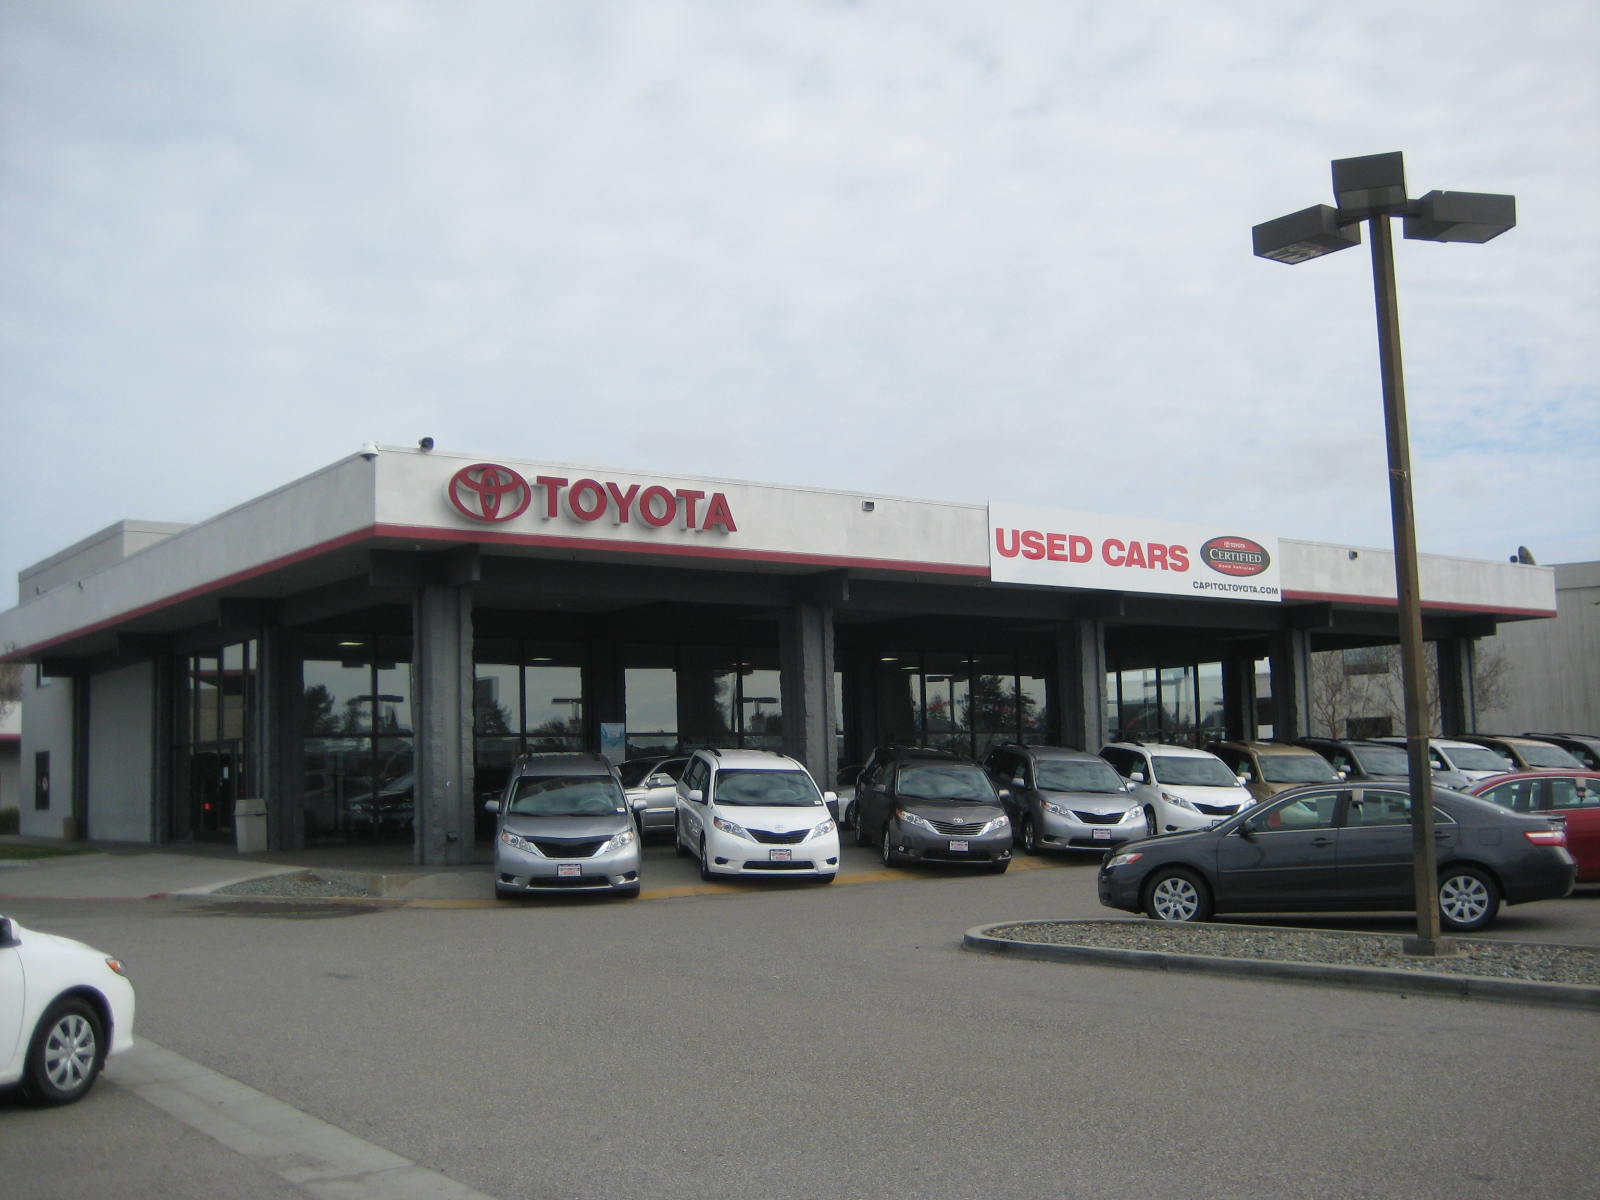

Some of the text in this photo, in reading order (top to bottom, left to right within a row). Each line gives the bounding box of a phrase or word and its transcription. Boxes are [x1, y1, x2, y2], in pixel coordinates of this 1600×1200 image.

[536, 475, 738, 533] TOYOTA
[995, 527, 1190, 573] USED CARS
[1209, 548, 1262, 563] CERTIFIED
[1192, 581, 1279, 595] CAPITOLTOYOTA.COM
